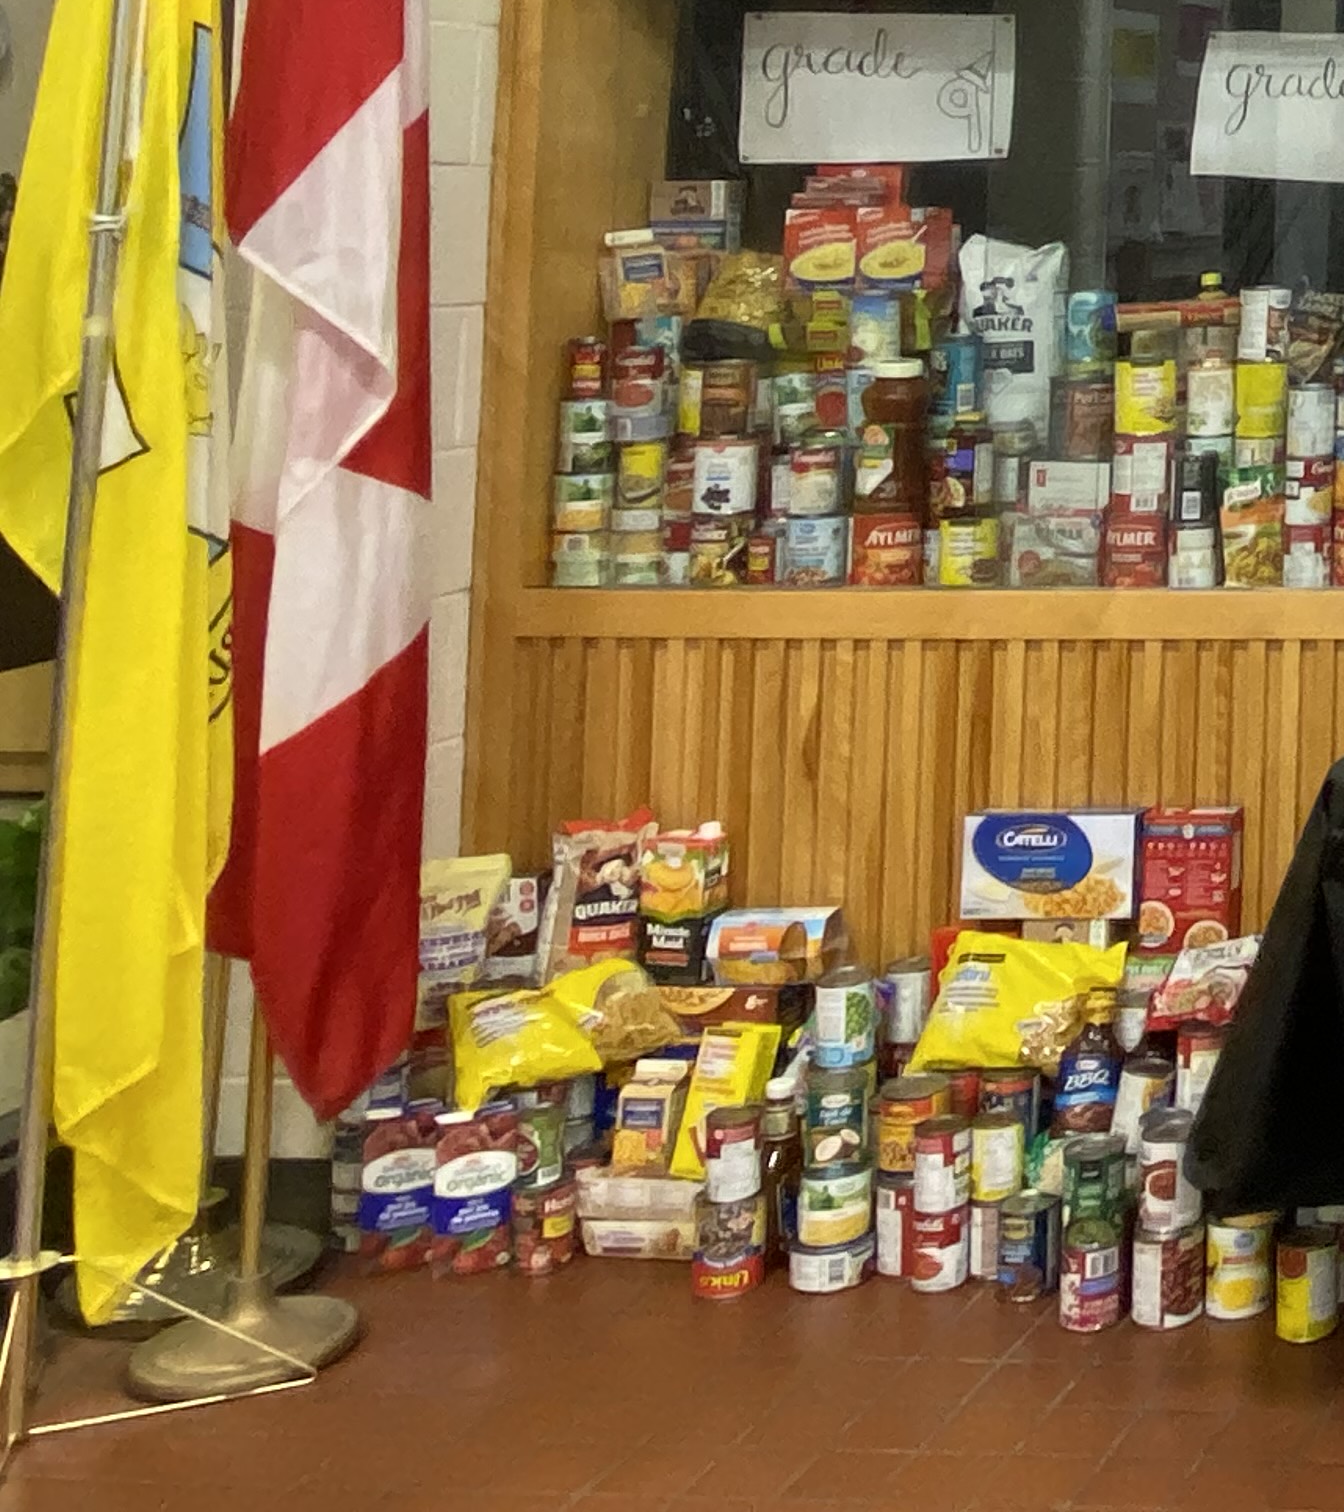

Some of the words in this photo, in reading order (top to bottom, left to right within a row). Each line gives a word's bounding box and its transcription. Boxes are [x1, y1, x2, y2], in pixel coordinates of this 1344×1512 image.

[762, 28, 922, 128] grade
[1003, 831, 1058, 848] CATELLI
[574, 899, 638, 920] QUAKER
[1065, 1069, 1112, 1091] BBQ
